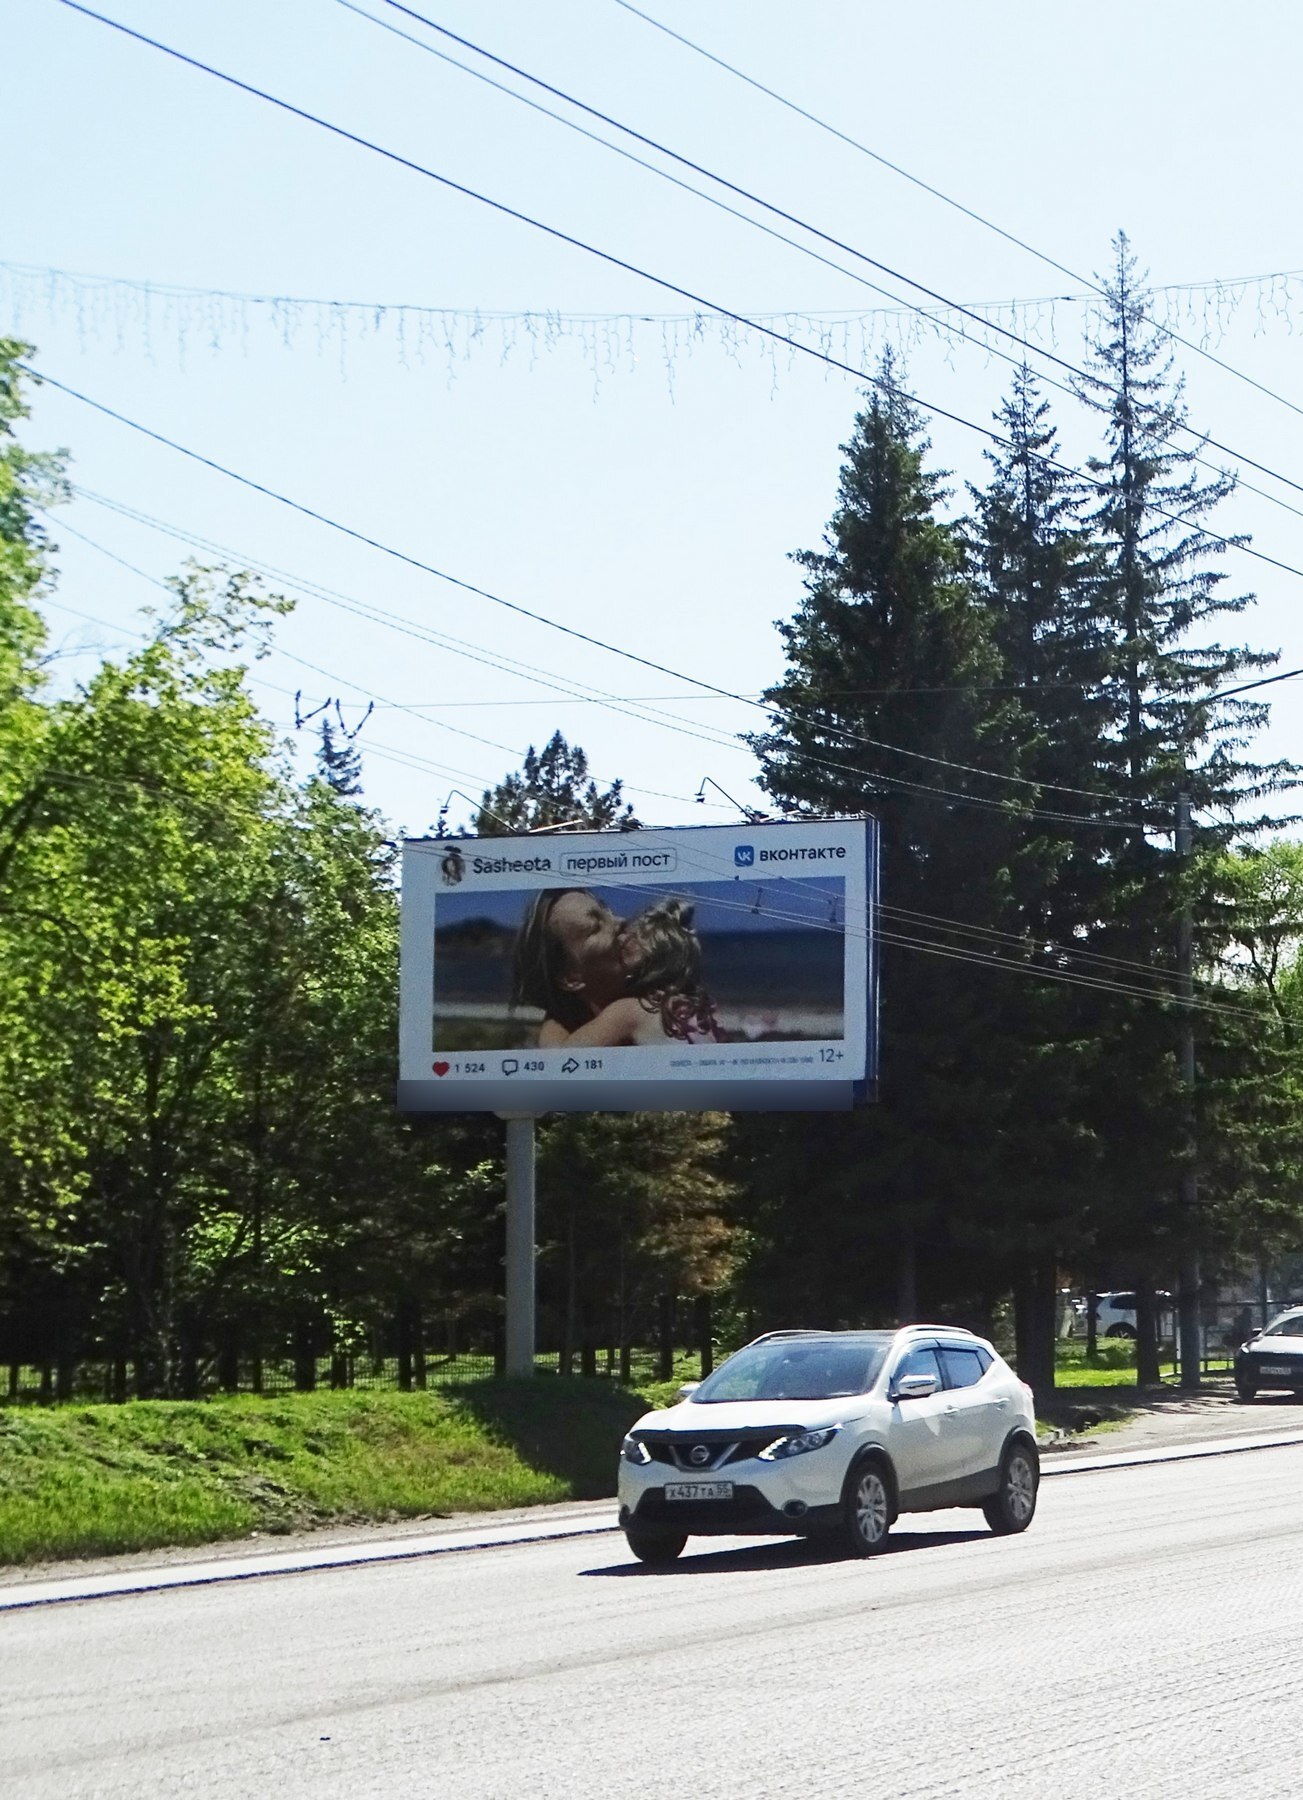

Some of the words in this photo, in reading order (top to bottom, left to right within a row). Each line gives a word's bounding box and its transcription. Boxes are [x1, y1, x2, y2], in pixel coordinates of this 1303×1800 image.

[473, 856, 552, 874] Sasheeta
[567, 853, 628, 873] первый
[633, 853, 671, 868] пост
[818, 1049, 844, 1063] 12+
[523, 1061, 545, 1072] 430
[584, 1060, 603, 1070] 181
